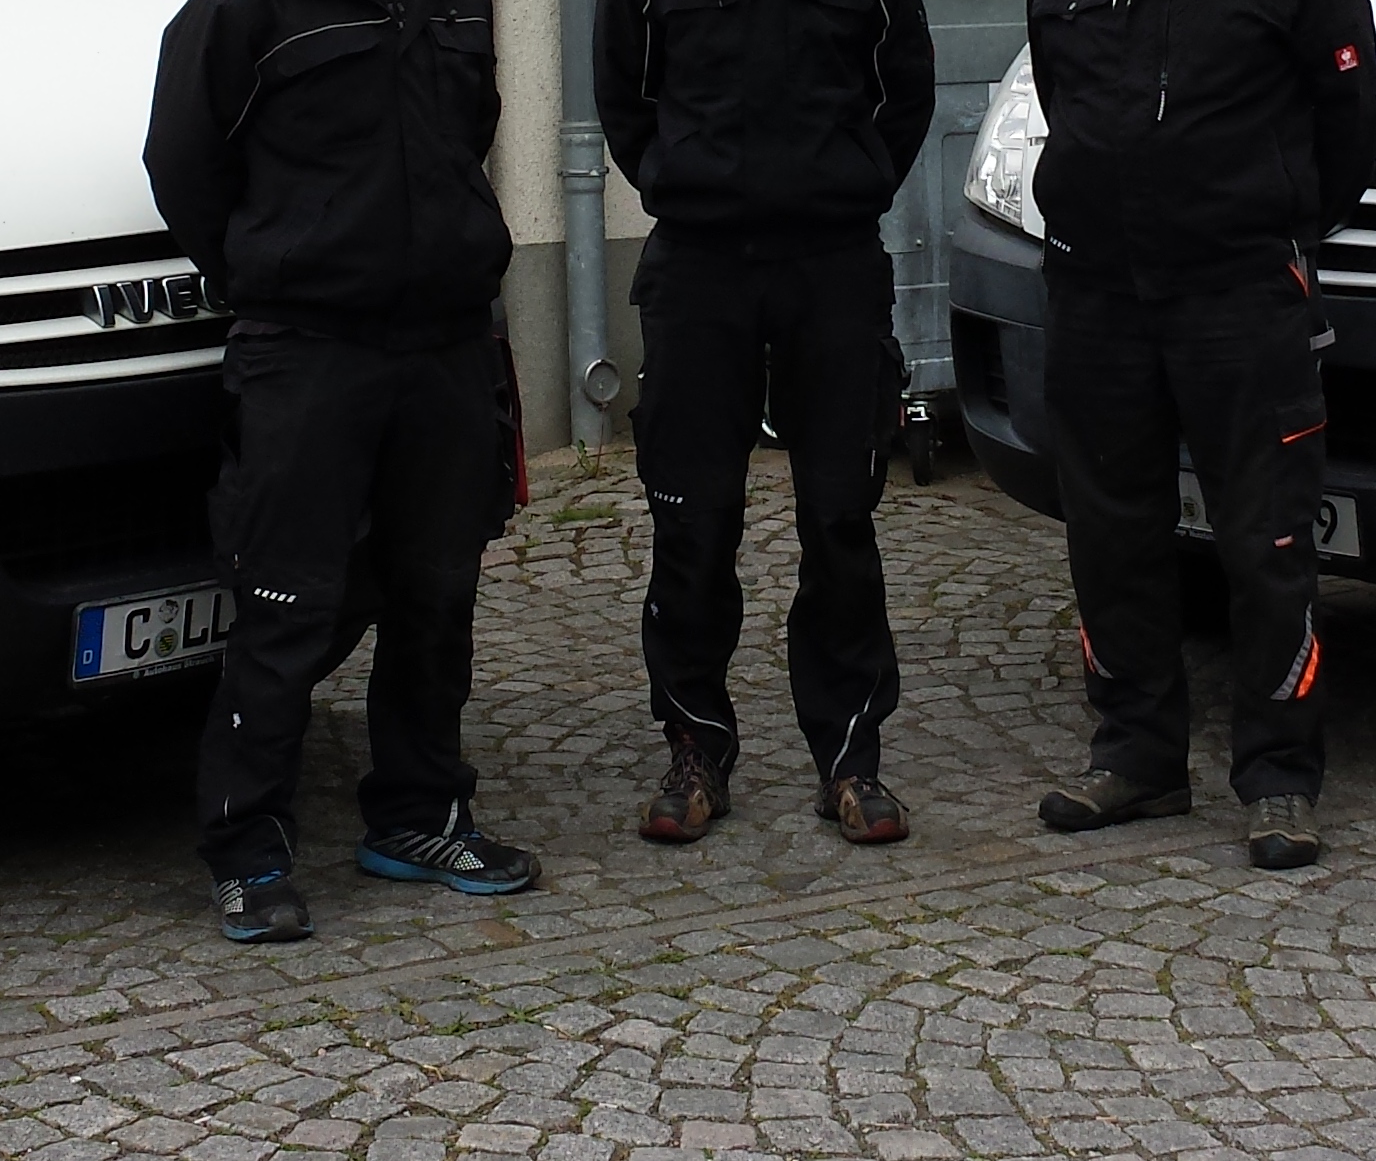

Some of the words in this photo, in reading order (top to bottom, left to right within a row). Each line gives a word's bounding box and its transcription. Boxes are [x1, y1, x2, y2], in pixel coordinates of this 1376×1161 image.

[124, 607, 151, 660] C
[181, 593, 229, 649] LL
[83, 649, 93, 665] D
